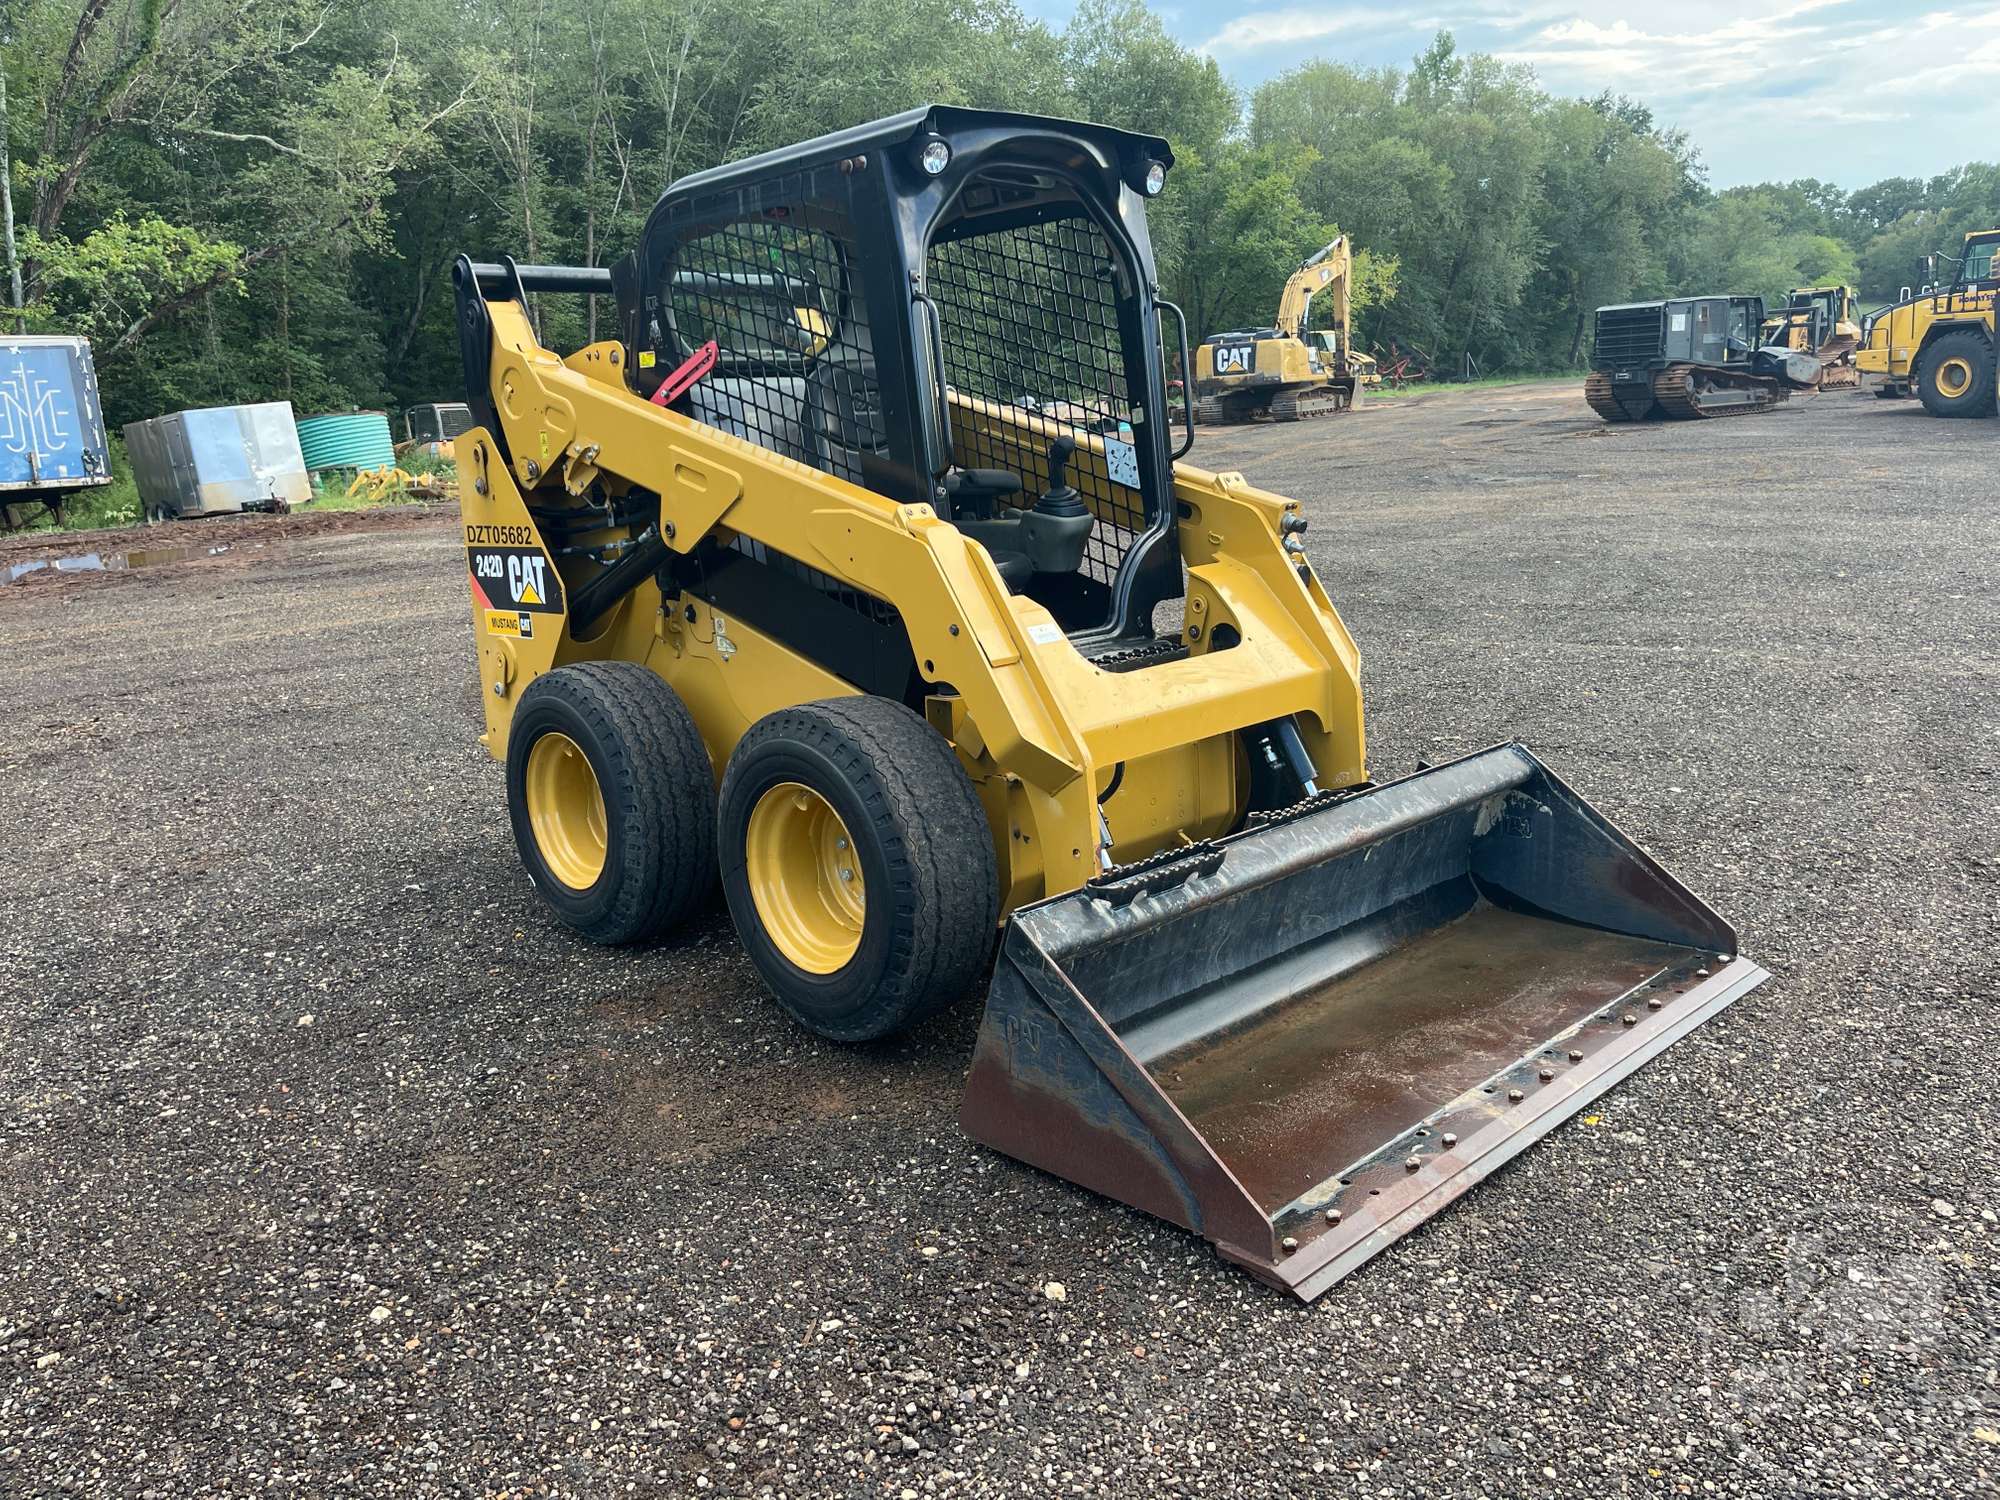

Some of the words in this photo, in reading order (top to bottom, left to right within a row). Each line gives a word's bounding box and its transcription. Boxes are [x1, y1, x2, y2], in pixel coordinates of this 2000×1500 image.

[1216, 347, 1252, 373] CAT
[466, 525, 533, 545] DZT05682
[475, 554, 504, 578] 242D
[507, 554, 546, 605] CAT
[491, 617, 519, 630] MUSTANG
